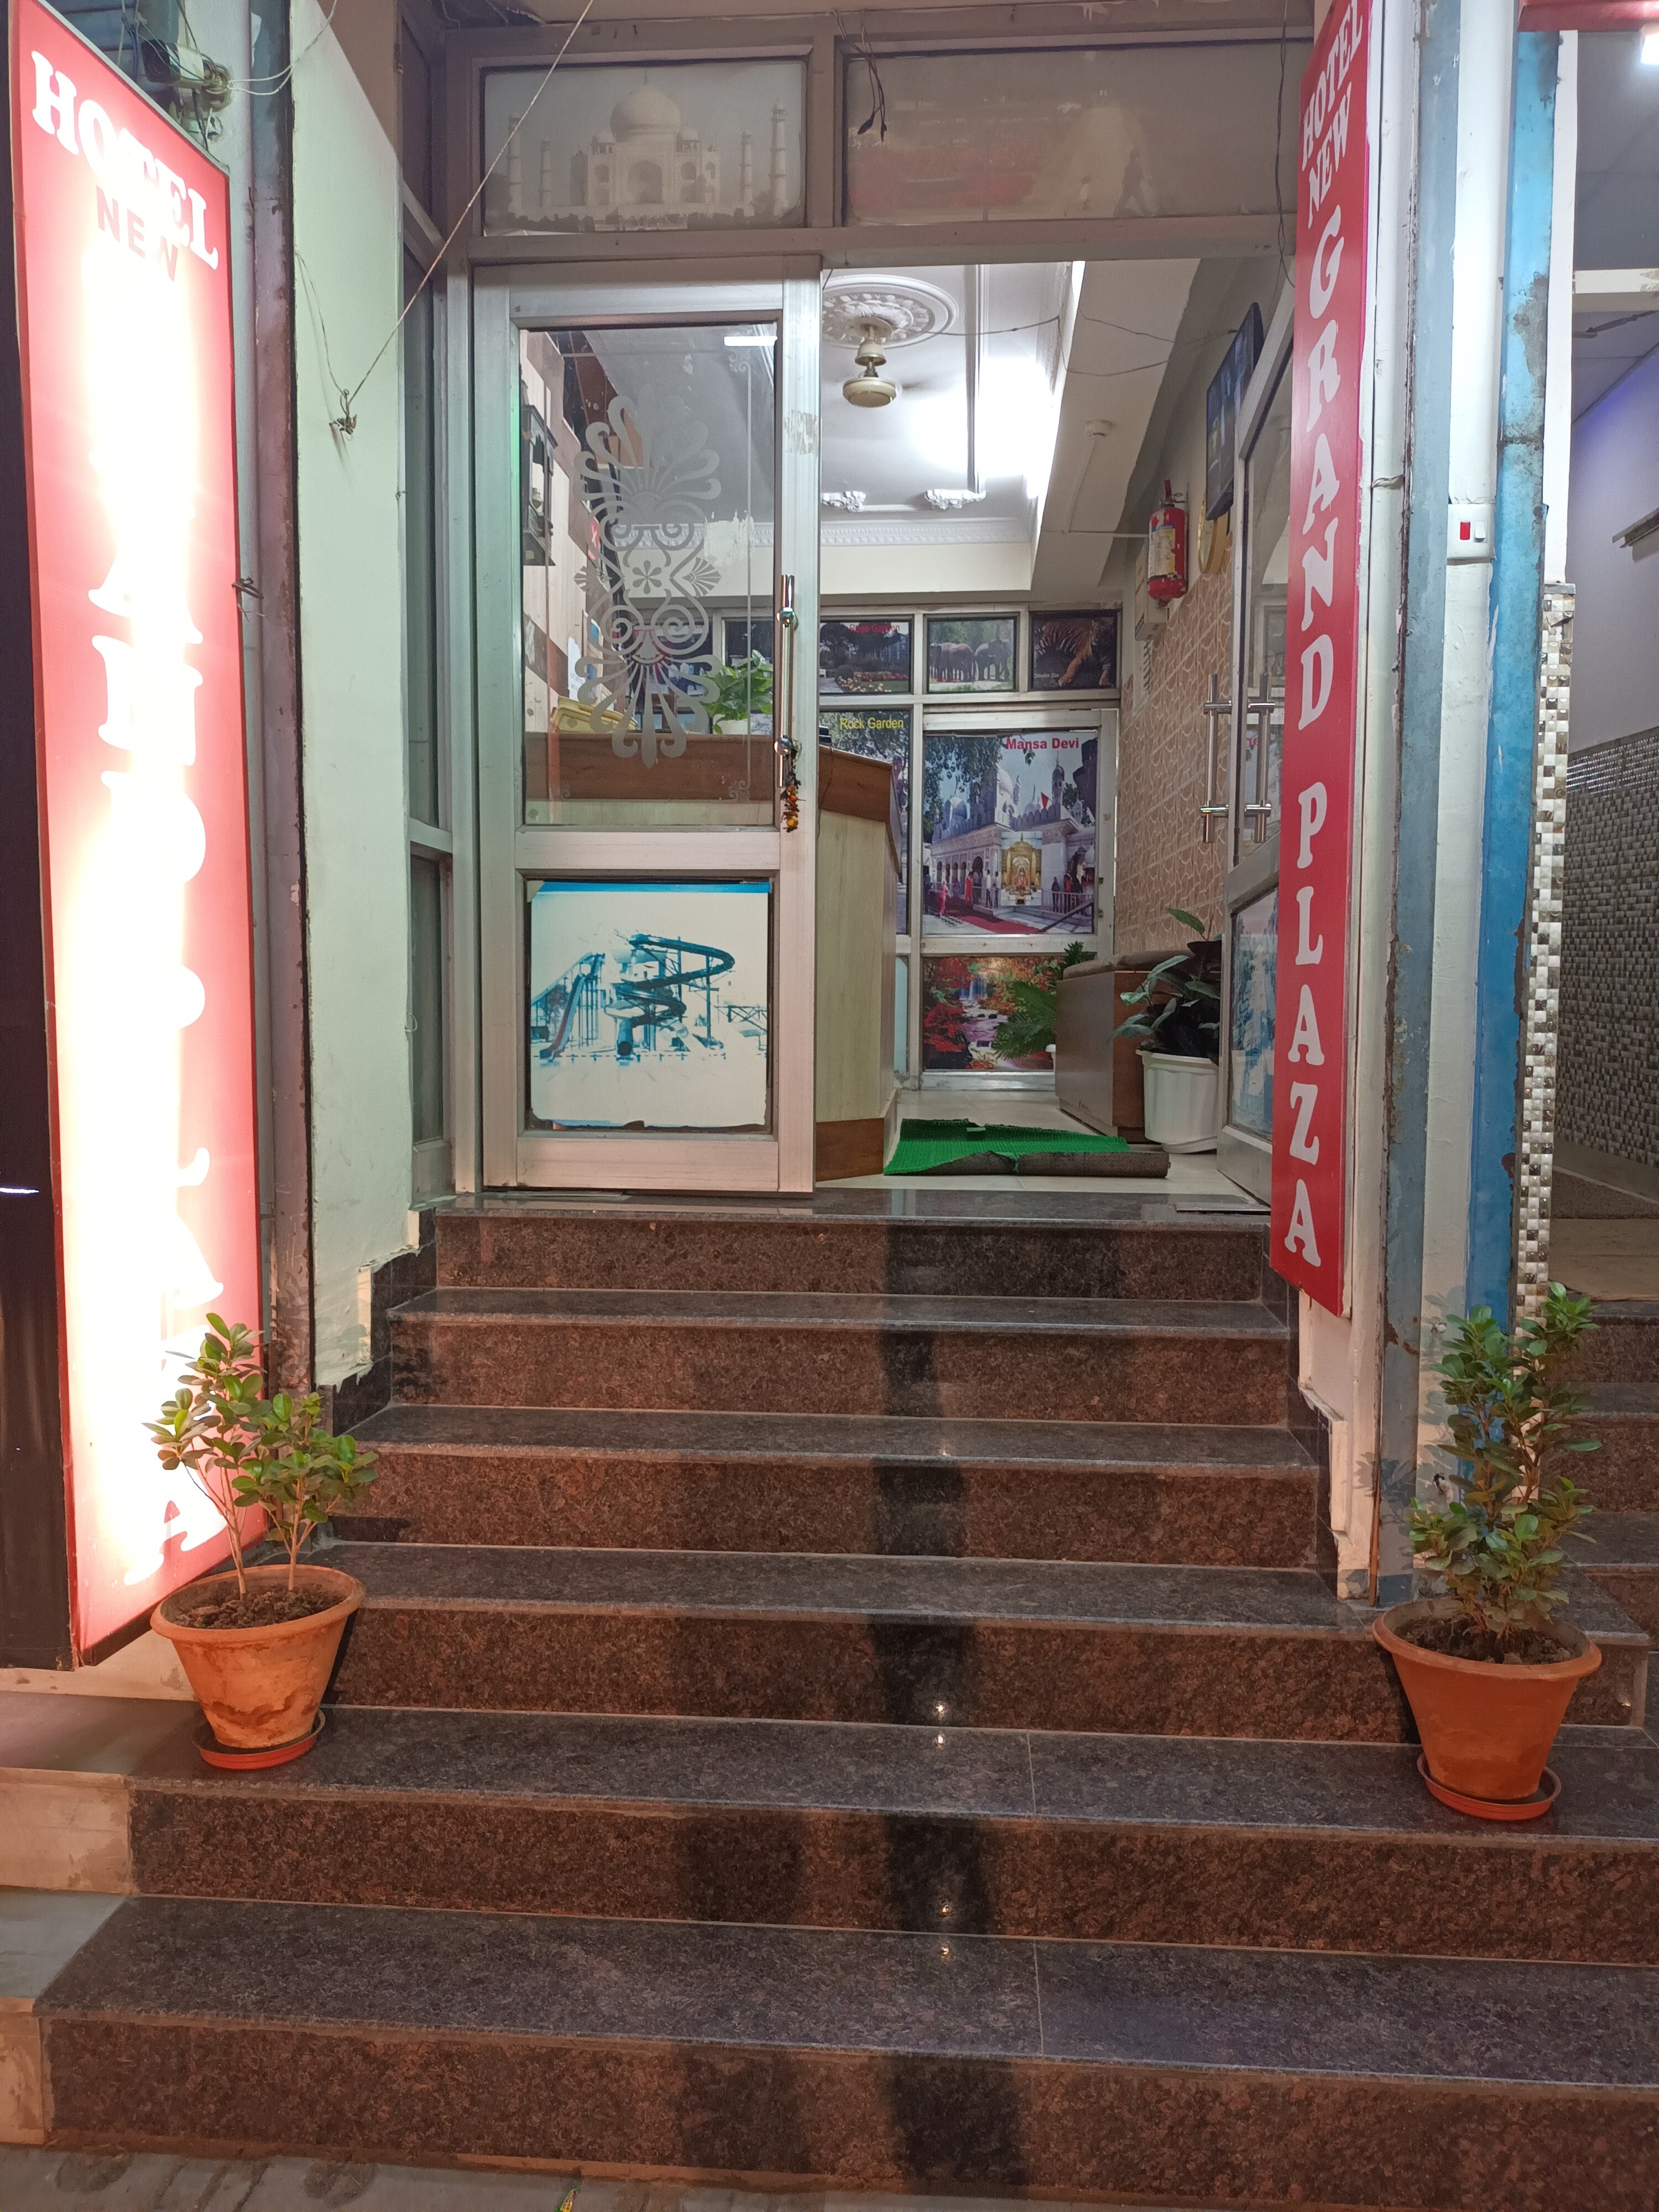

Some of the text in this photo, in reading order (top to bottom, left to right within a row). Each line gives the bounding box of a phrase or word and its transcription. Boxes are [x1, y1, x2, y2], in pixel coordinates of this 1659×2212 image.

[32, 50, 219, 270] HOTEL
[1301, 0, 1363, 172] HOTEL
[1308, 81, 1352, 229] NEW
[1298, 205, 1345, 731] GRAND
[872, 623, 900, 632] Garden
[839, 717, 904, 730] Rock Garden
[1004, 737, 1079, 749] Mansa Devi
[1284, 781, 1327, 1267] PLAZA
